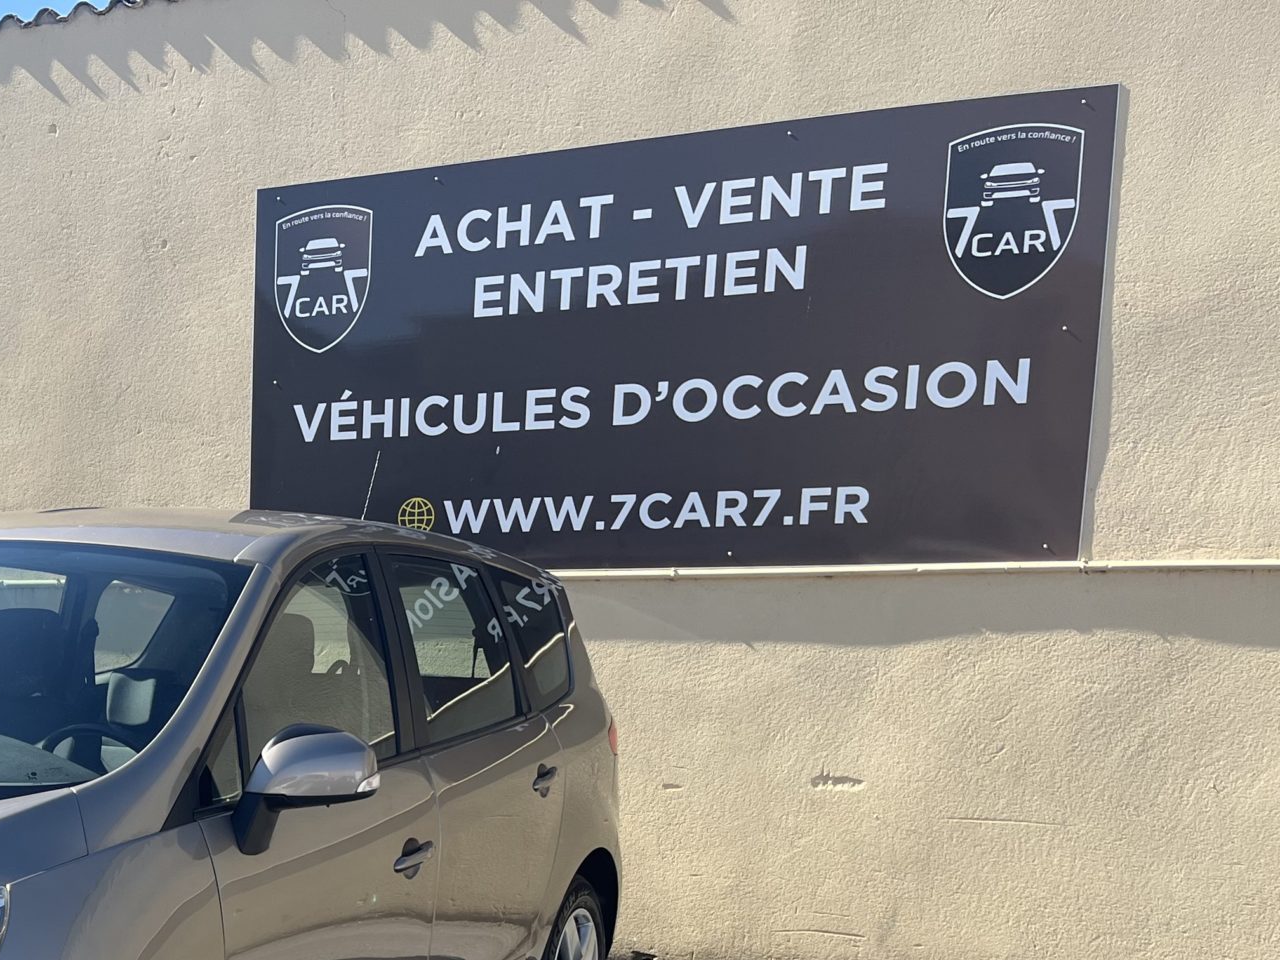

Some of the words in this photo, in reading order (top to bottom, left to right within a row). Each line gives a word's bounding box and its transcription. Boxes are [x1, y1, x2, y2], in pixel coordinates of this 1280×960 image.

[957, 144, 970, 153] En
[970, 136, 996, 149] route
[997, 132, 1016, 142] vers
[1017, 131, 1027, 139] la
[1027, 131, 1071, 143] confiance
[282, 222, 291, 230] En
[291, 217, 310, 226] route
[309, 213, 324, 221] vers
[331, 211, 363, 221] confiance
[414, 194, 615, 258] ACHAT
[674, 162, 889, 229] VENTE
[473, 245, 807, 318] ENTRETIEN
[293, 386, 591, 443] VÉHICULES
[443, 486, 870, 534] WWW.7CAR7.FR
